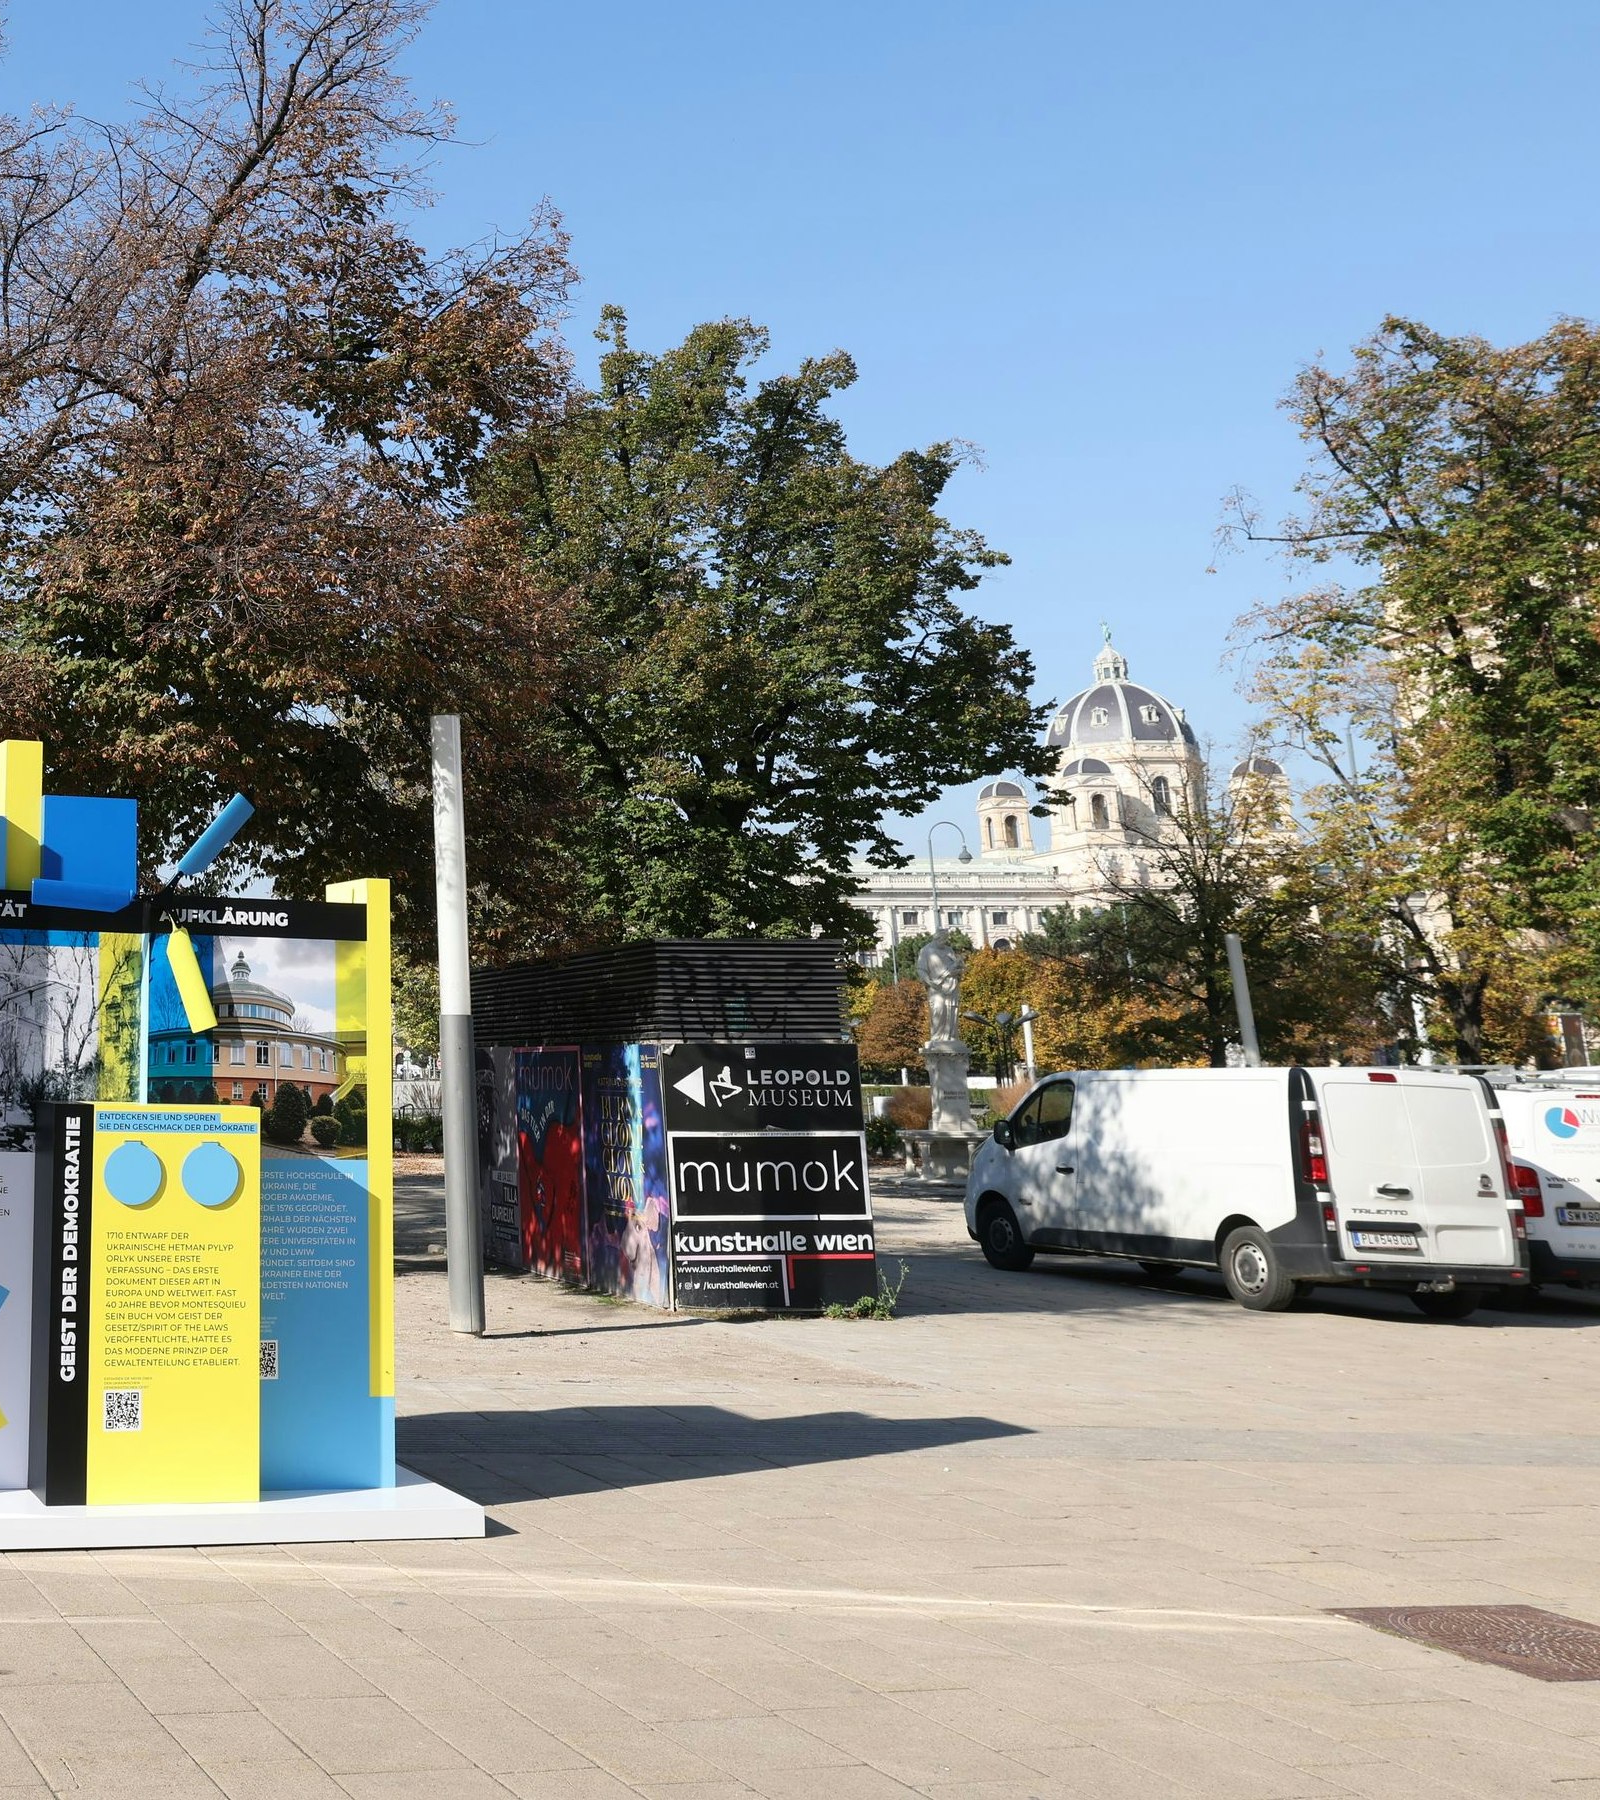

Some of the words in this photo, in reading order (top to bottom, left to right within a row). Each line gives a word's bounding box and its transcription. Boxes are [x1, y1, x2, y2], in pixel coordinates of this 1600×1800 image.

[160, 906, 288, 926] AUFKLÄRUNG
[520, 1057, 573, 1091] mumok
[746, 1069, 850, 1086] LEOPOLD
[748, 1089, 853, 1106] MUSEUM
[99, 1112, 148, 1121] ENTDECKEN
[149, 1113, 162, 1121] SIE
[163, 1113, 182, 1121] UND
[183, 1114, 216, 1122] SPÜREN
[98, 1122, 112, 1130] SIE
[112, 1122, 131, 1130] DEN
[132, 1123, 183, 1131] GESCHMACK
[184, 1123, 201, 1131] DER
[203, 1123, 255, 1132] DEMOKRATIE
[680, 1150, 859, 1192] mumok
[63, 1117, 80, 1260] DEMOKRATIE
[106, 1231, 123, 1239] 1710
[125, 1231, 168, 1239] ENTWARF
[170, 1232, 189, 1240] DER
[106, 1243, 166, 1251] UKRAINISCHE
[168, 1243, 205, 1251] HETMAN
[207, 1243, 234, 1252] PYLYP
[106, 1254, 134, 1262] ORLYK
[136, 1254, 172, 1263] UNSERE
[174, 1254, 200, 1263] ERSTE
[105, 1266, 164, 1274] VERFASSUNG
[172, 1266, 191, 1274] DAS
[192, 1266, 219, 1274] ERSTE
[677, 1265, 772, 1273] www.kunsthallewien.at
[105, 1277, 157, 1285] DOKUMENT
[159, 1277, 191, 1286] DIESER
[192, 1277, 209, 1285] ART
[703, 1281, 779, 1290] /kunsthallewien.at
[62, 1267, 77, 1312] DER
[60, 1320, 76, 1381] GEIST
